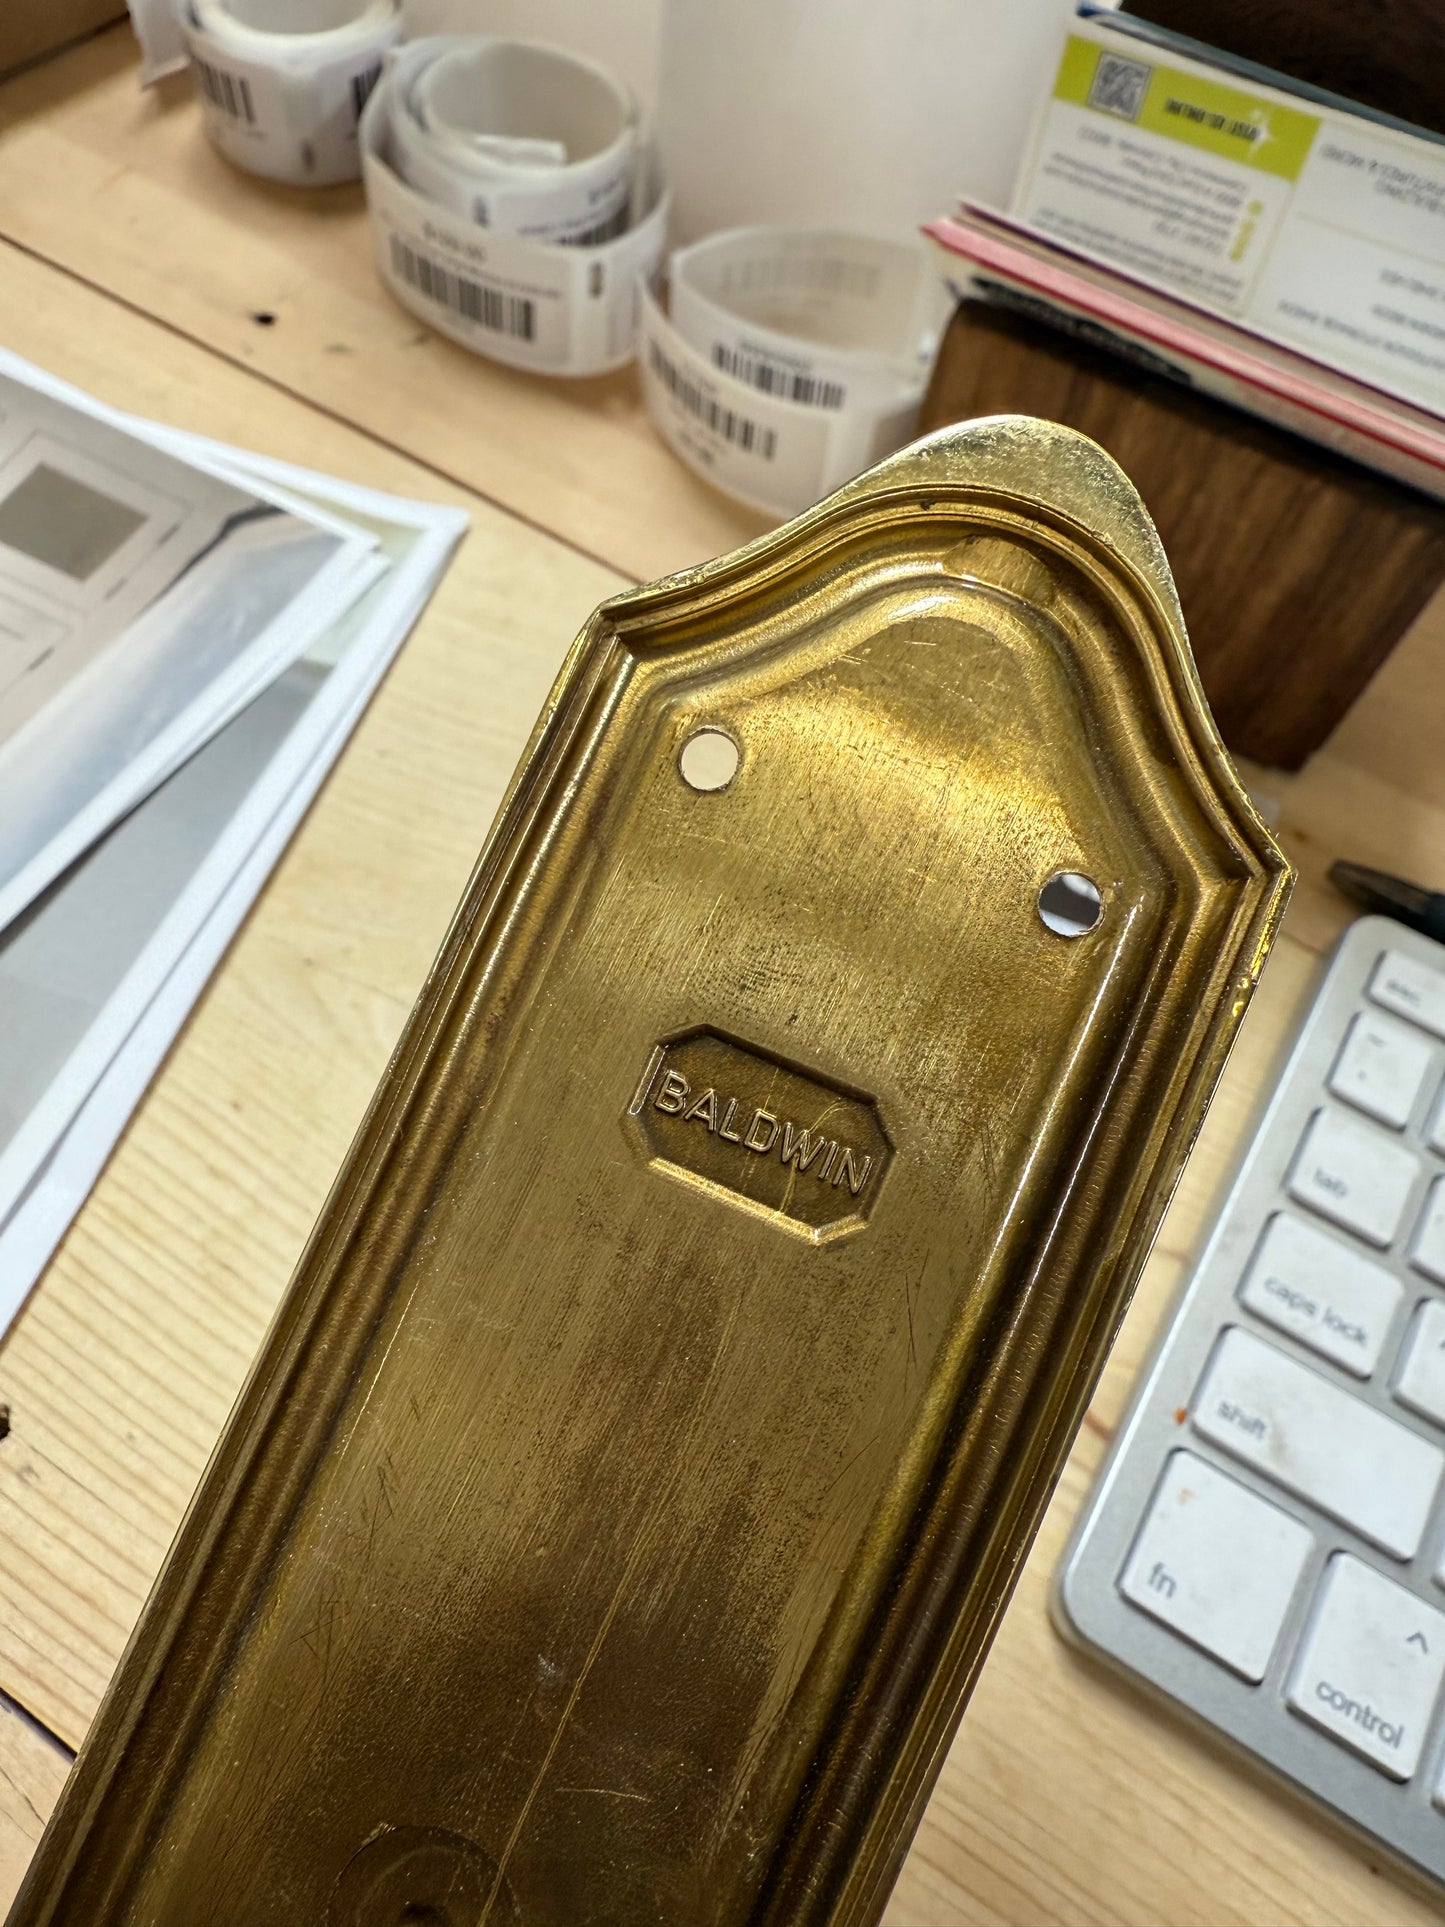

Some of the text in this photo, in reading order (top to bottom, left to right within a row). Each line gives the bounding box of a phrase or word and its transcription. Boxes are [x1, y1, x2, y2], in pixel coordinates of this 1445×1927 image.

[654, 1069, 873, 1194] BALDWIN
[1313, 1165, 1347, 1197] tab
[1264, 1274, 1368, 1347] caps lock
[1218, 1400, 1268, 1442] shift
[1149, 1561, 1176, 1600] fn
[1315, 1679, 1406, 1750] control
